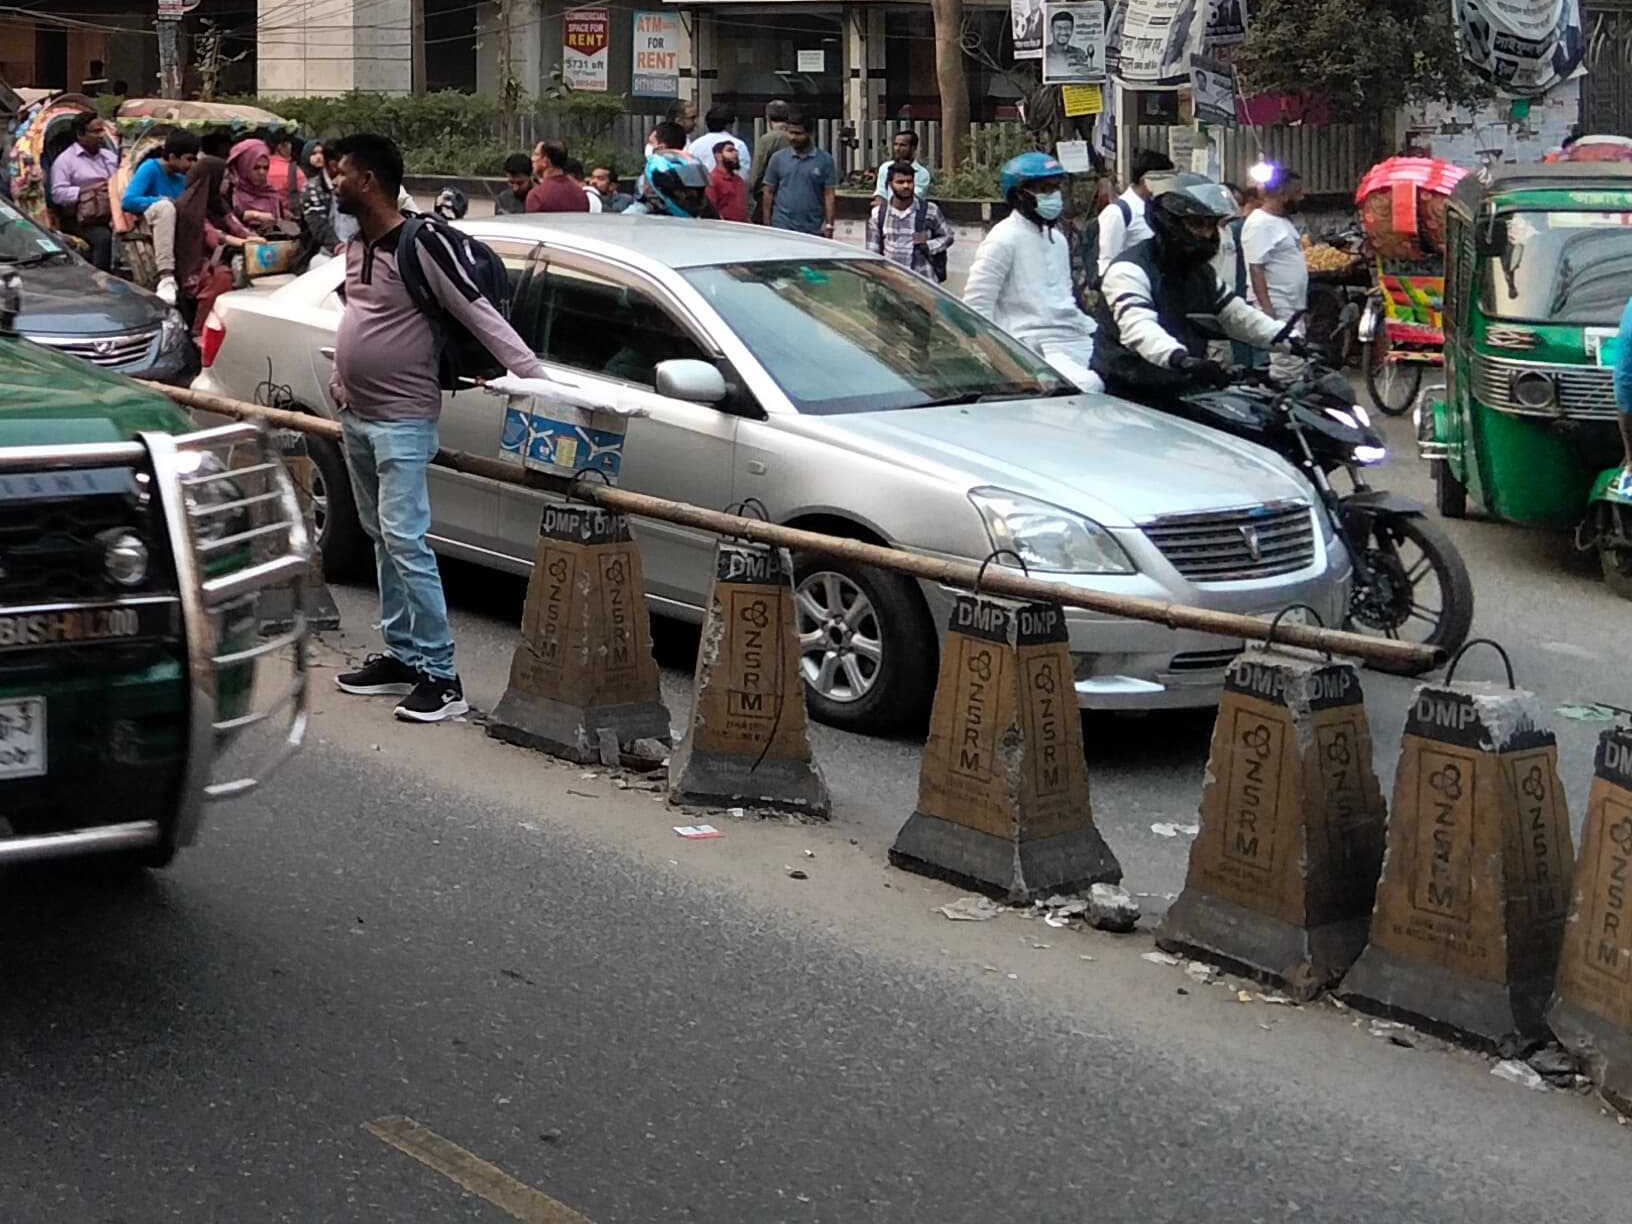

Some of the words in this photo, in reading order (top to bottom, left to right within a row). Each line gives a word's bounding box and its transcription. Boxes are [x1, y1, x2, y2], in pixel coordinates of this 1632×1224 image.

[569, 23, 588, 32] SPACE
[590, 23, 603, 32] FOR
[638, 16, 662, 33] ATM
[569, 34, 604, 46] RENT
[648, 37, 664, 48] FOR
[638, 52, 676, 70] RENT
[545, 509, 581, 533] DMP
[958, 599, 1005, 633] DMP
[1021, 610, 1058, 635] DMP
[1235, 663, 1284, 697] DMP
[1312, 674, 1350, 700] DMP
[1417, 696, 1477, 731] DMP
[959, 682, 985, 772] ZSRM
[1041, 699, 1060, 788] ZSRM
[1236, 758, 1264, 858] ZSRM
[1598, 856, 1628, 967] ZSRM
